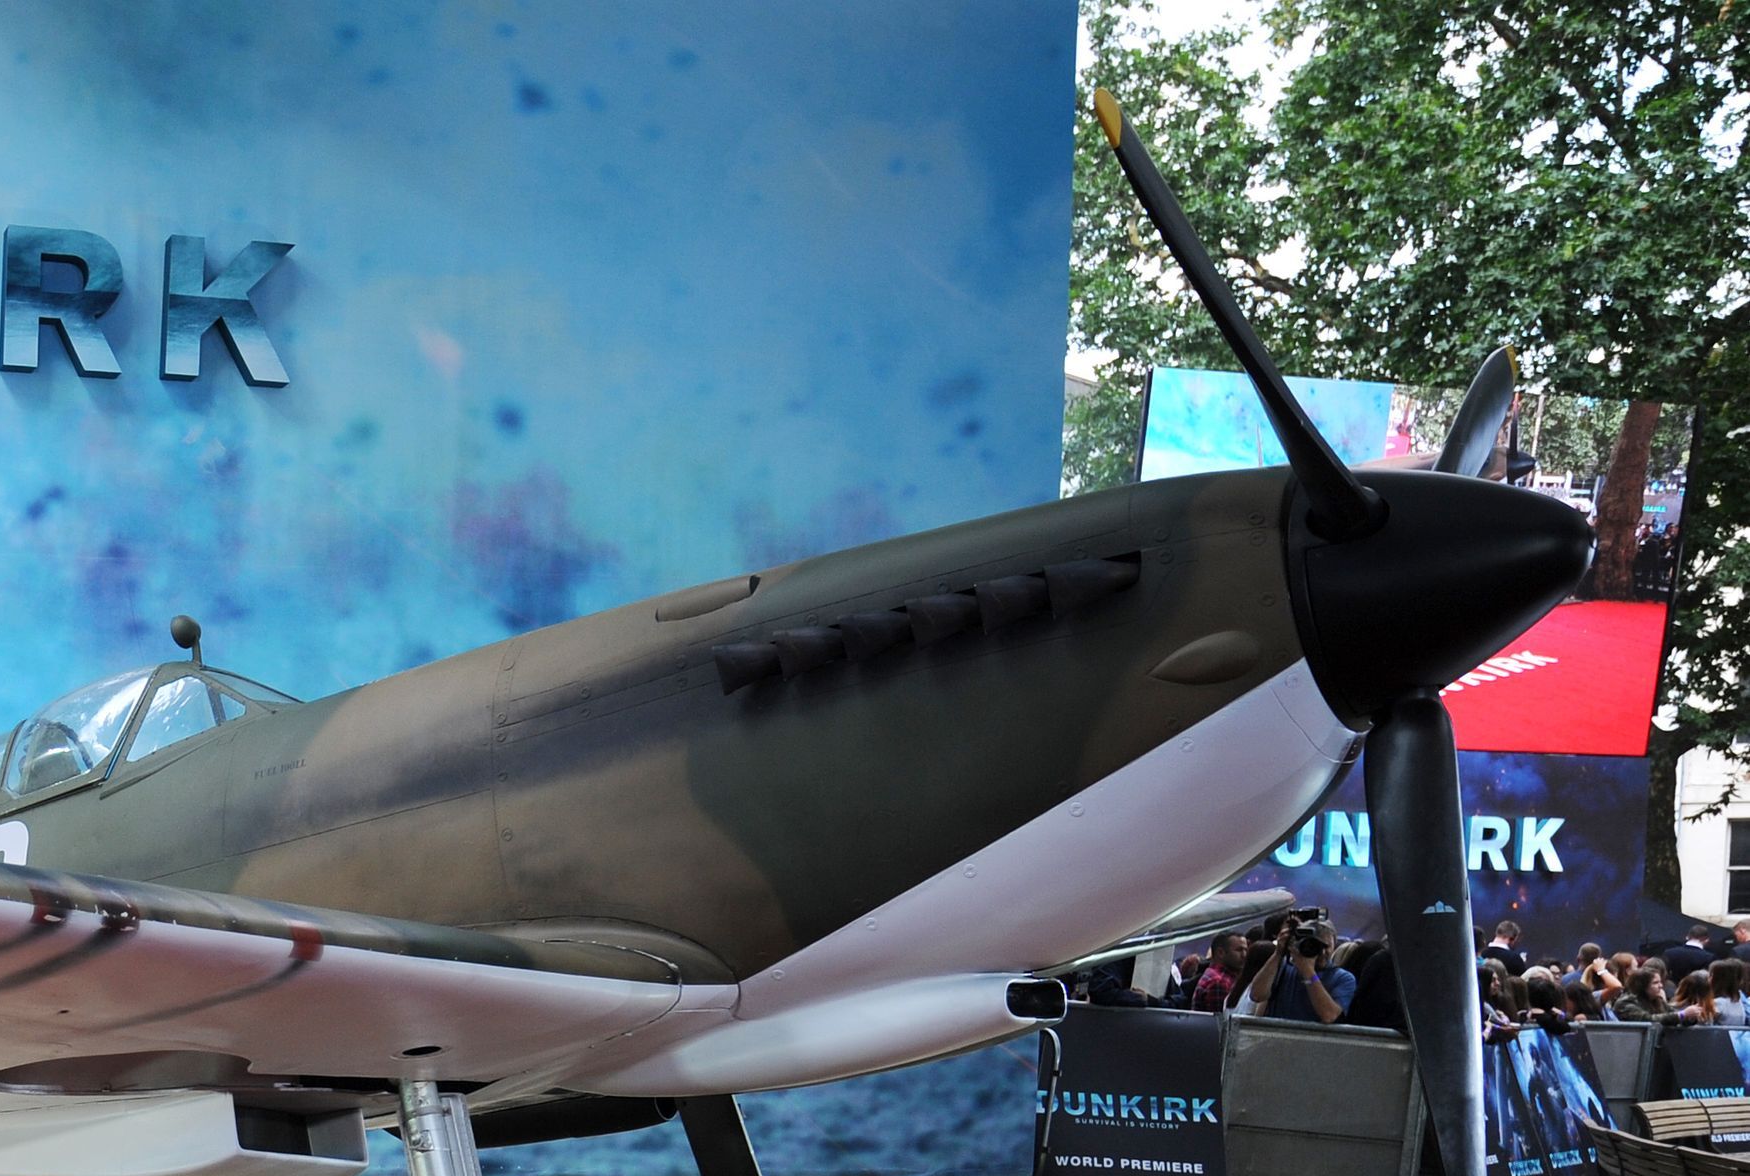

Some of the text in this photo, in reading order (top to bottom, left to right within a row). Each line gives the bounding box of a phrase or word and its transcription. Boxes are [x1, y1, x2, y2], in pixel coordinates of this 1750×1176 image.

[1036, 1090, 1218, 1123] DUNKIRK
[1075, 1118, 1121, 1127] SURVIVAL
[1140, 1122, 1180, 1130] VICTORY
[1055, 1155, 1204, 1174] WORLD PREMIERE
